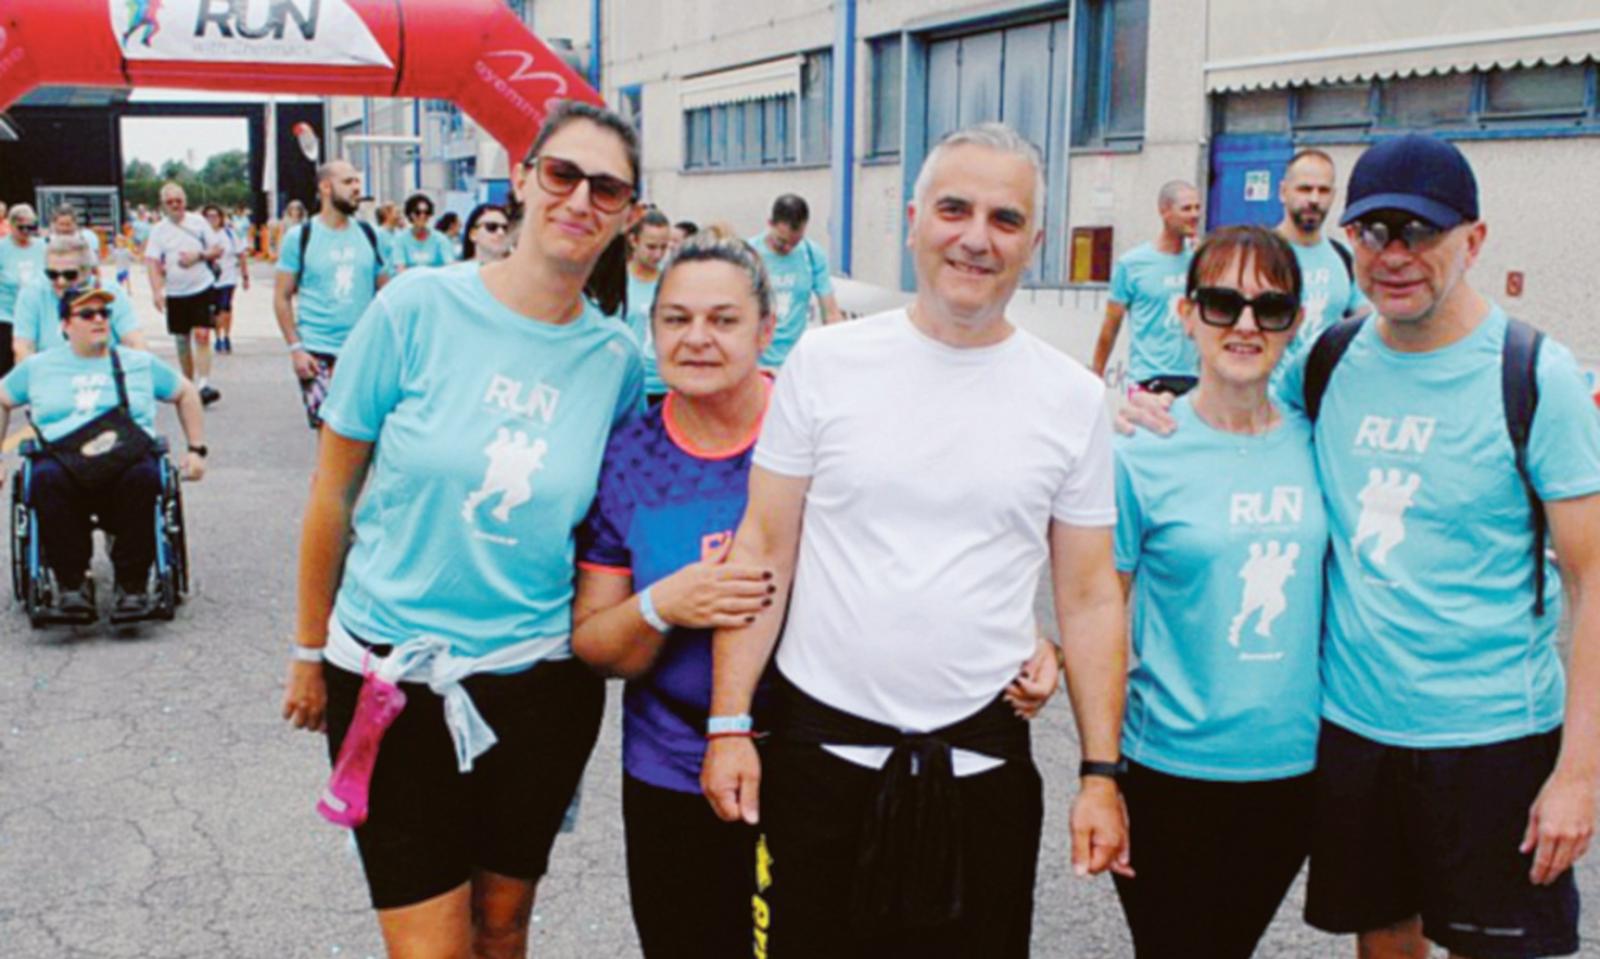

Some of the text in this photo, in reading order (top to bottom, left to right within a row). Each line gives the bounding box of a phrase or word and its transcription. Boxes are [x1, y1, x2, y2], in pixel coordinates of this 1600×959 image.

[194, 0, 321, 41] RUN
[484, 373, 561, 423] RUN
[1354, 414, 1437, 452] RUN
[1230, 485, 1303, 524] RUN
